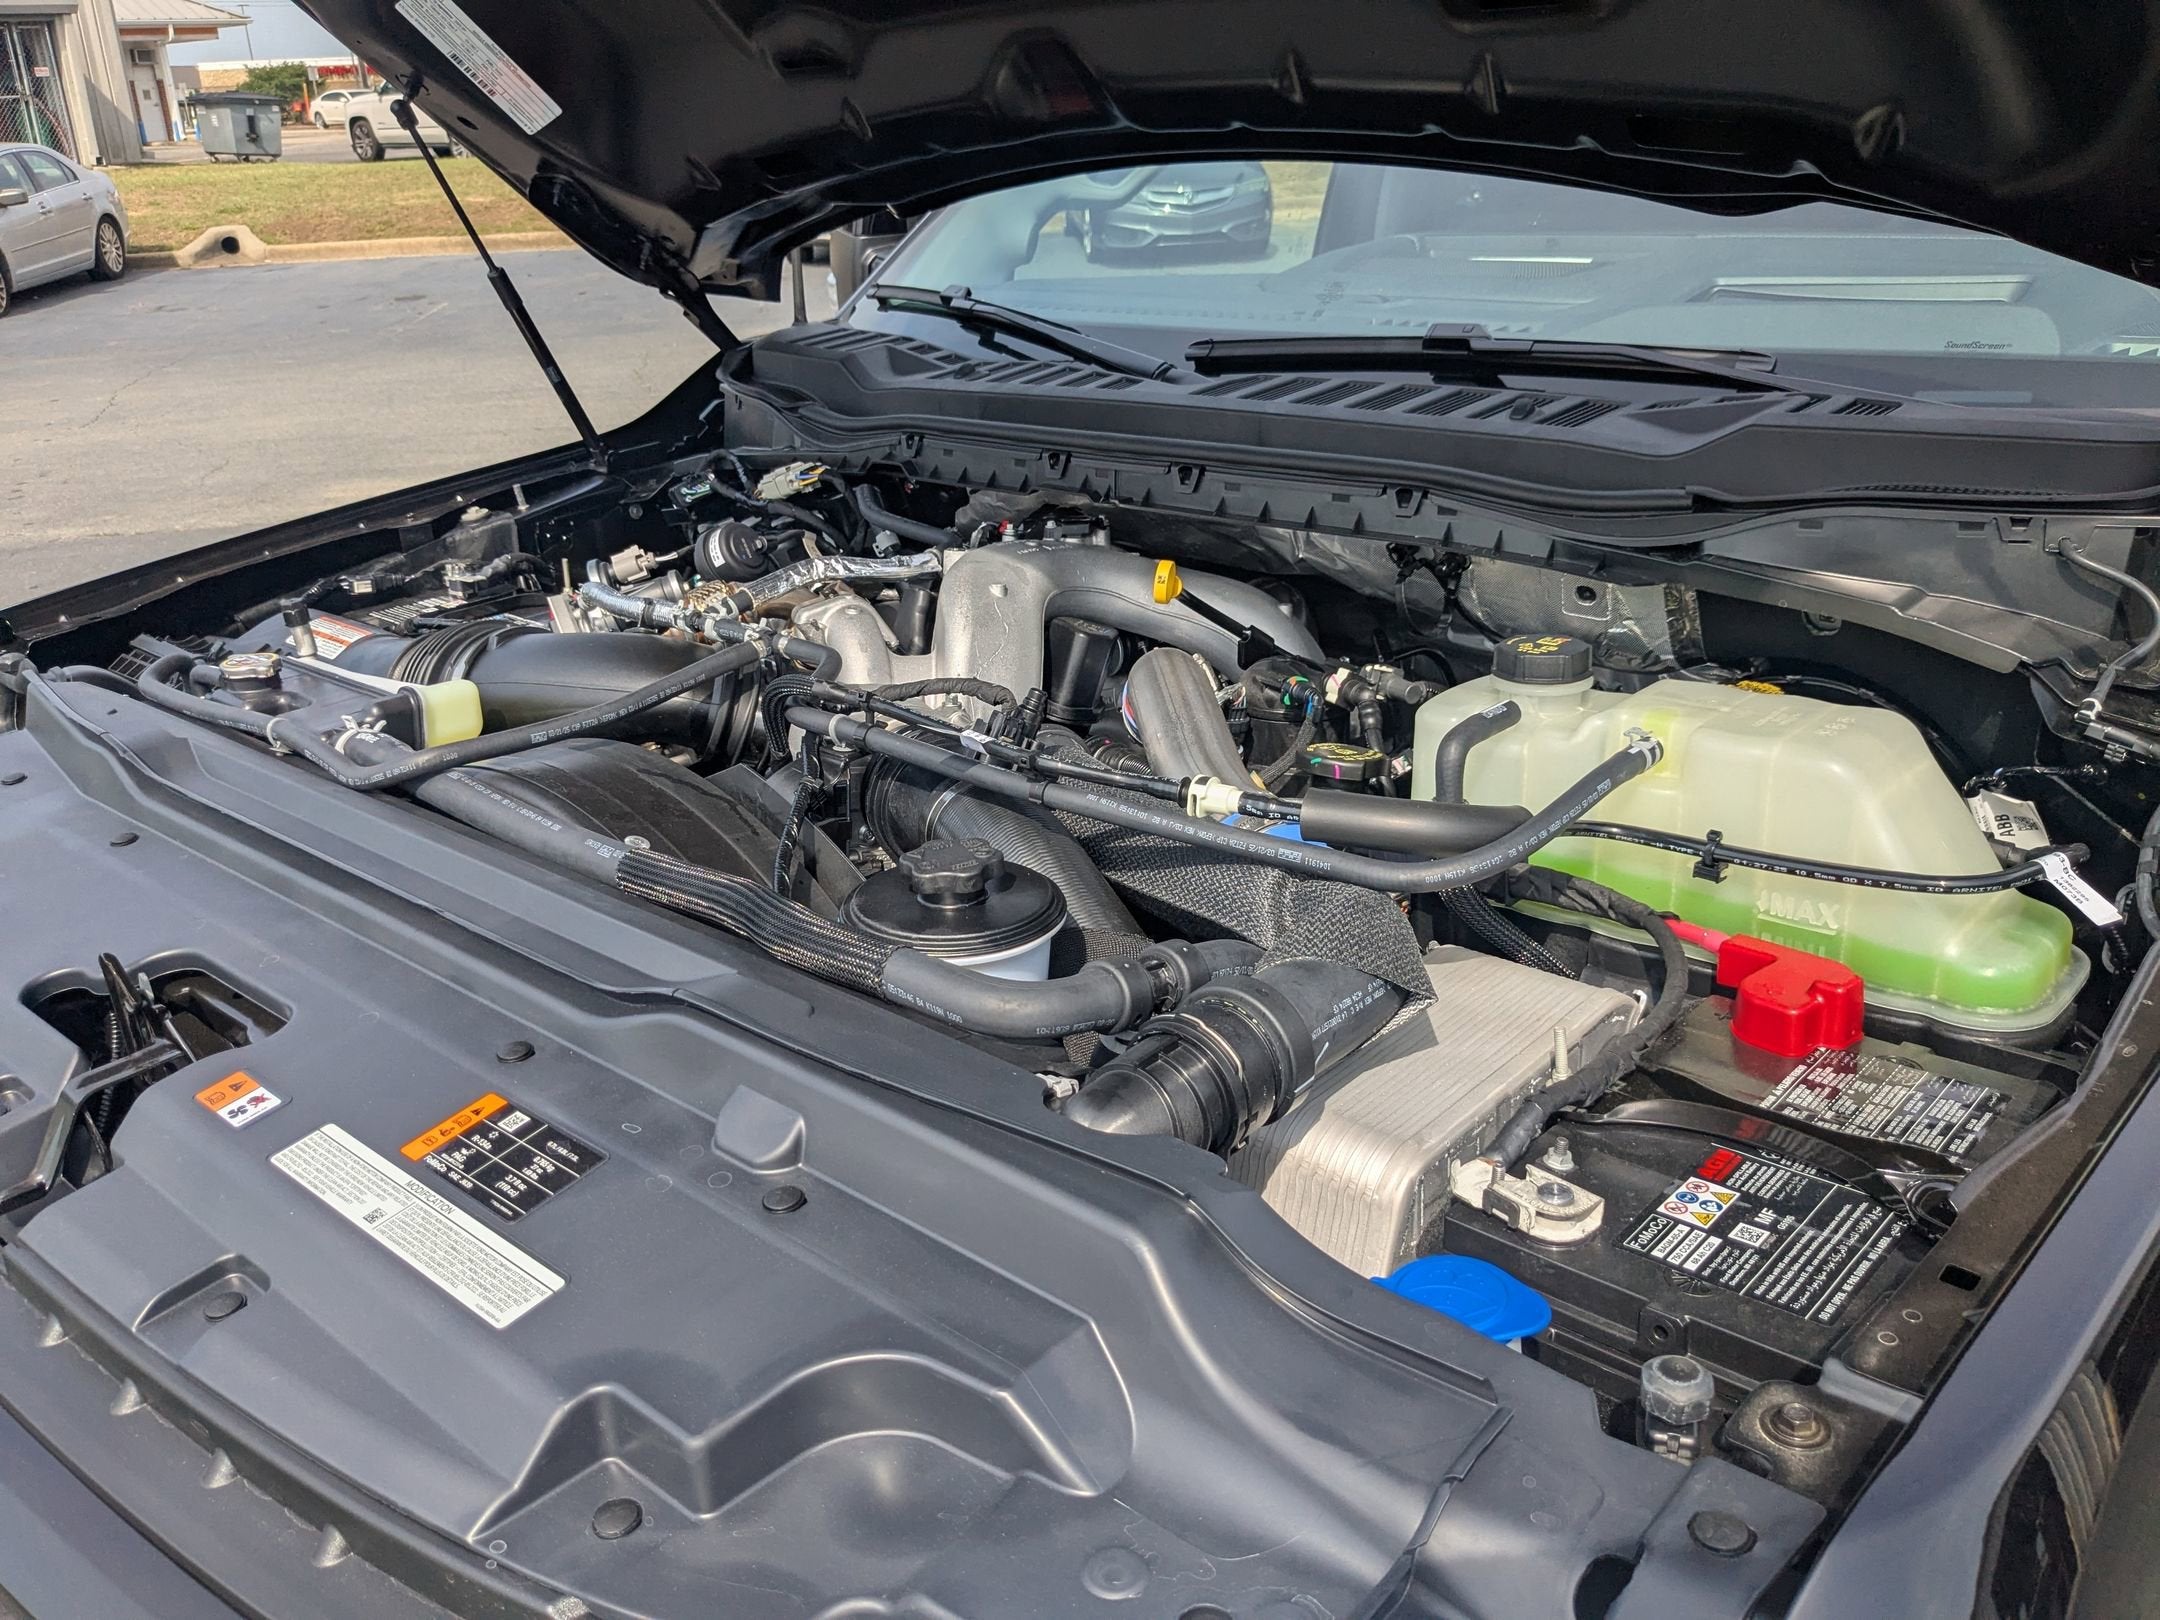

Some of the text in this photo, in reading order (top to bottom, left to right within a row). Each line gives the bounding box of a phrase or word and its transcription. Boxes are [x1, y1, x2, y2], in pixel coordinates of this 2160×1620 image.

[1995, 814, 2016, 837] ABB
[1769, 891, 1840, 930] MAX
[470, 1135, 493, 1148] R-134a
[423, 1155, 448, 1171] FoMoCo
[450, 1151, 466, 1162] PAG
[404, 1180, 454, 1214] MODIFICATION
[1754, 1207, 1779, 1224] MF
[1630, 1217, 1667, 1248] FoMoCo
